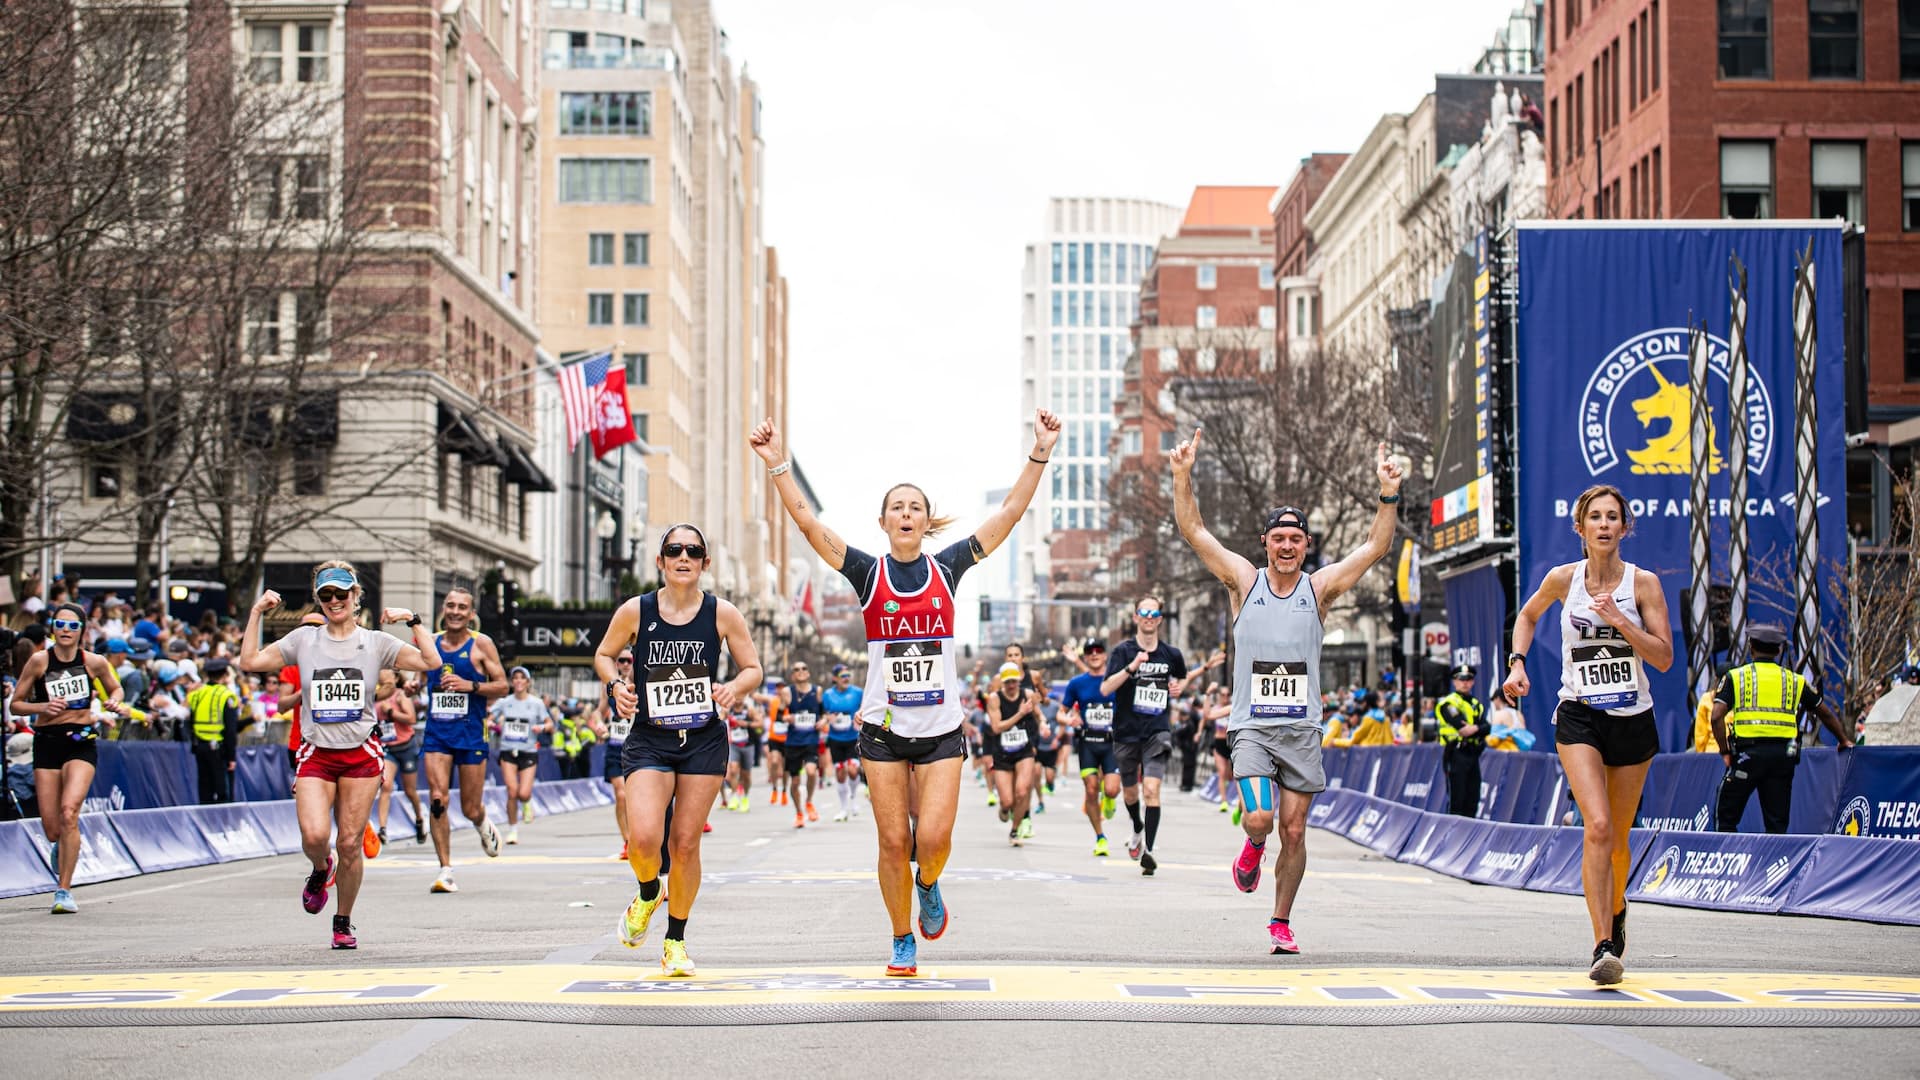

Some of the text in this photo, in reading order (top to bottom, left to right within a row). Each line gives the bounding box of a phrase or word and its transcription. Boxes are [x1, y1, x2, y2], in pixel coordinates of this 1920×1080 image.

[1586, 335, 1767, 464] 128TH BOSTON ATHON
[1630, 498, 1776, 517] OF AERCA
[880, 614, 946, 636] ITALIA
[523, 627, 591, 647] LENOX
[648, 641, 705, 665] NAVY
[892, 660, 934, 683] 9517
[1579, 661, 1632, 686] 15069
[52, 680, 84, 697] 15131
[317, 684, 360, 701] 13445
[653, 682, 706, 706] 12253
[1139, 689, 1165, 703] 11427
[1261, 678, 1296, 697] 8141
[1876, 802, 1905, 828] THE
[1681, 850, 1708, 874] THE
